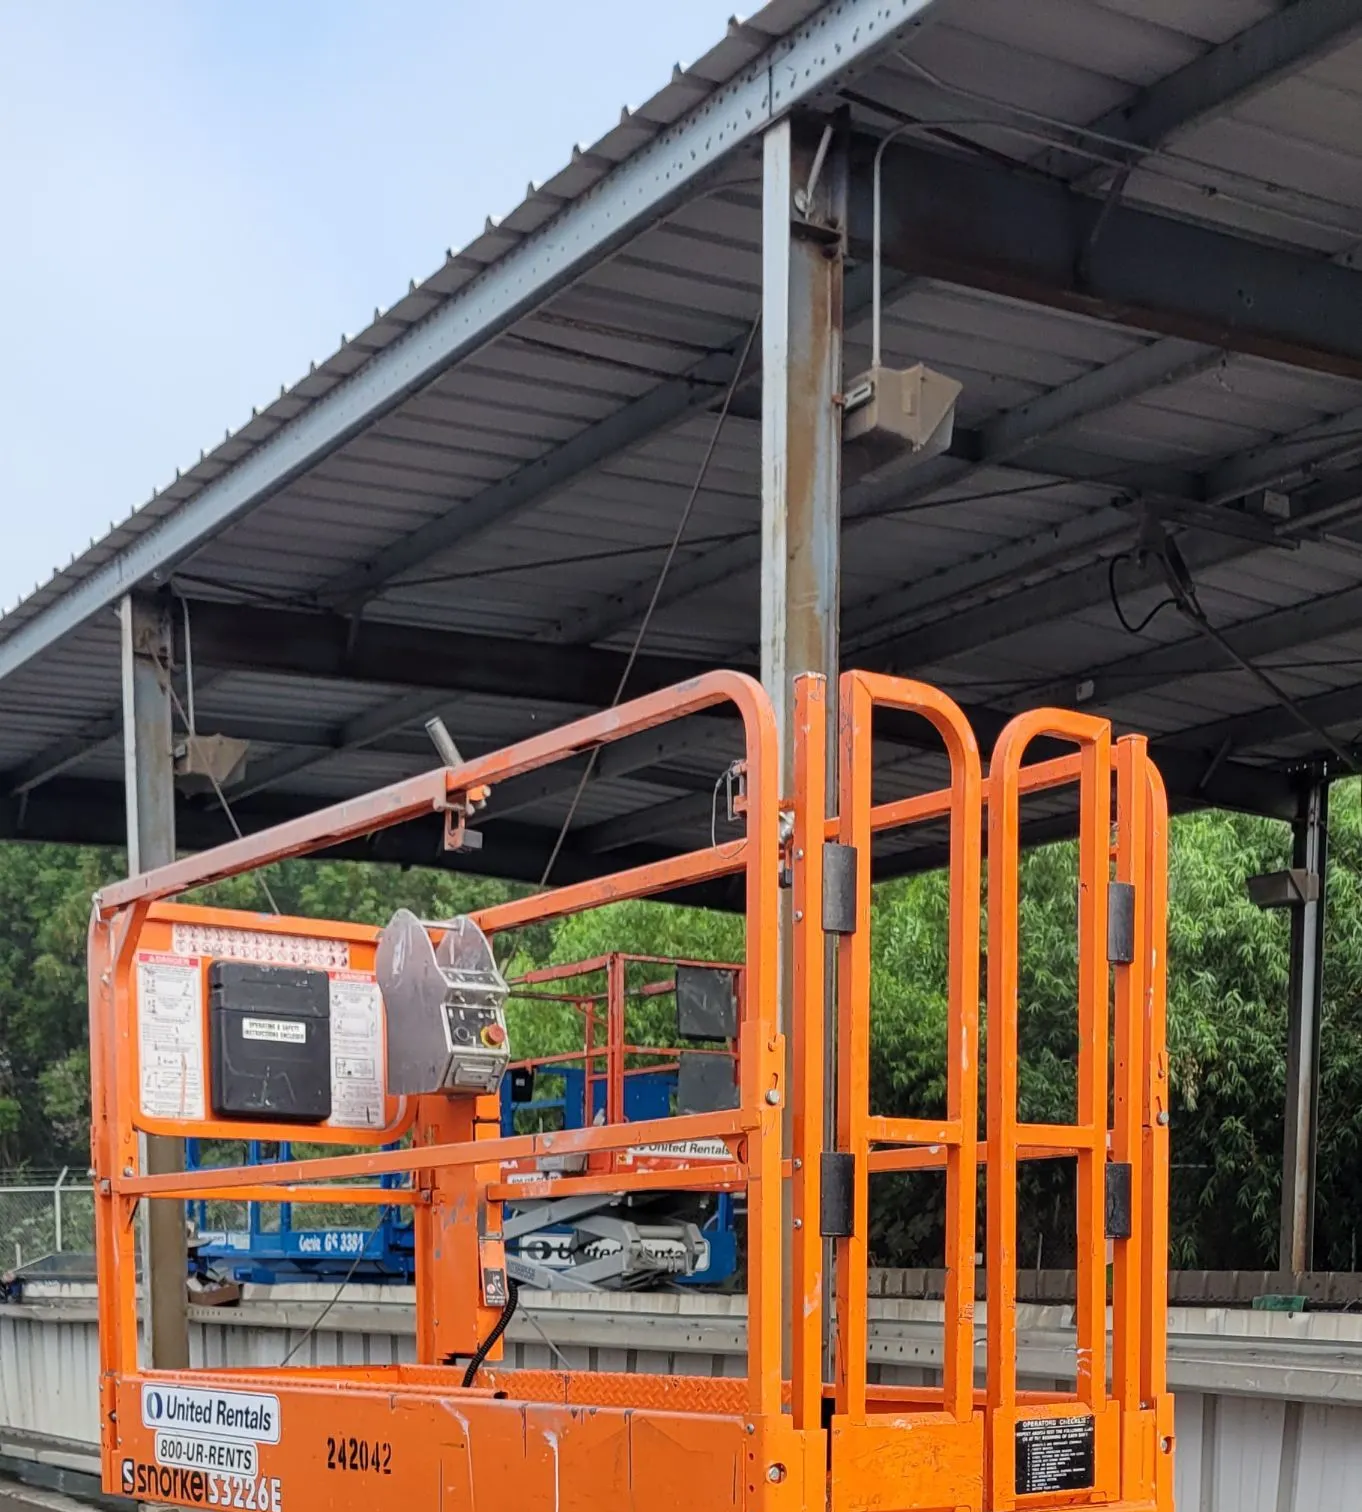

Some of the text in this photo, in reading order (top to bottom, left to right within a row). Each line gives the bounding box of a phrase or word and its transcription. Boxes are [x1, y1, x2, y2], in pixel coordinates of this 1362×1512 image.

[166, 1394, 272, 1431] United Rentals
[160, 1439, 252, 1470] 800-UR-RENTS
[327, 1437, 391, 1475] 242042
[137, 1464, 208, 1502] snorkel
